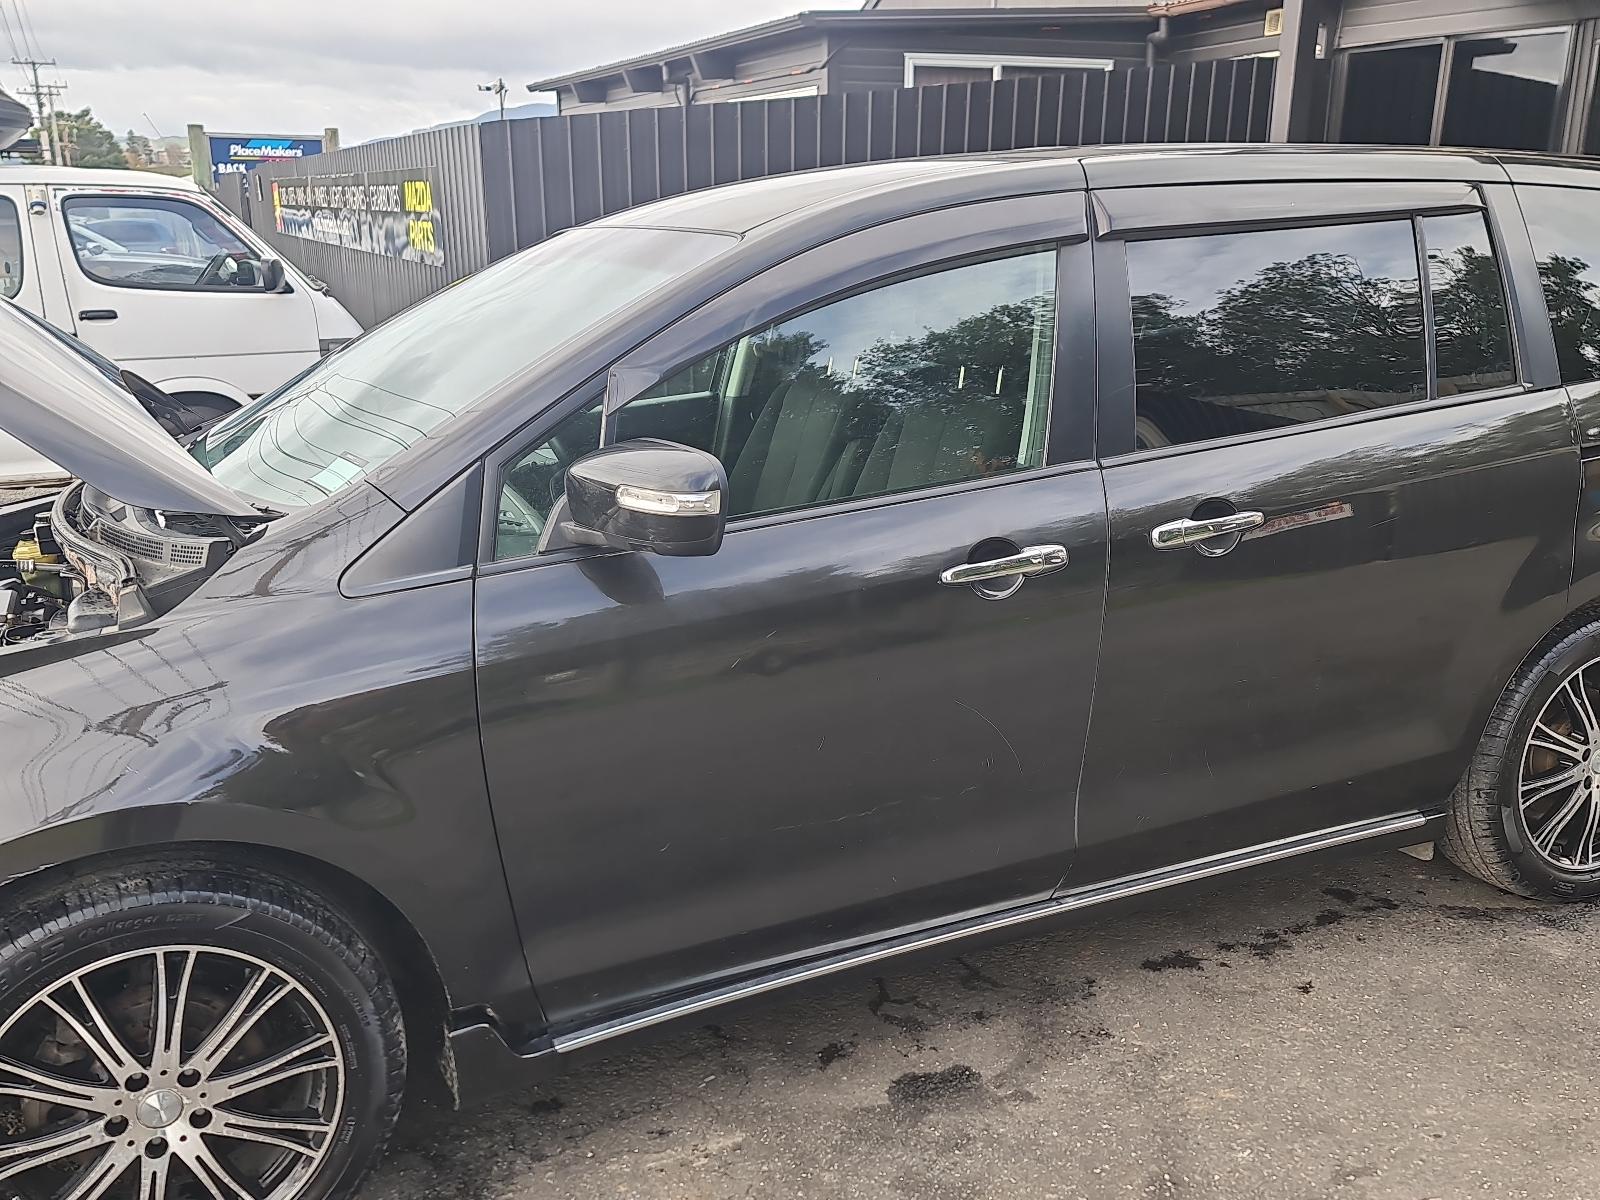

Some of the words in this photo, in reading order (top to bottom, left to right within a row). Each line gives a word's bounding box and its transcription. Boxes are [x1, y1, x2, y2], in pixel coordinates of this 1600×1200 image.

[229, 144, 303, 157] PlaceMakers
[218, 163, 247, 174] BACK
[404, 181, 432, 212] MAZDA
[409, 219, 434, 254] PARTS
